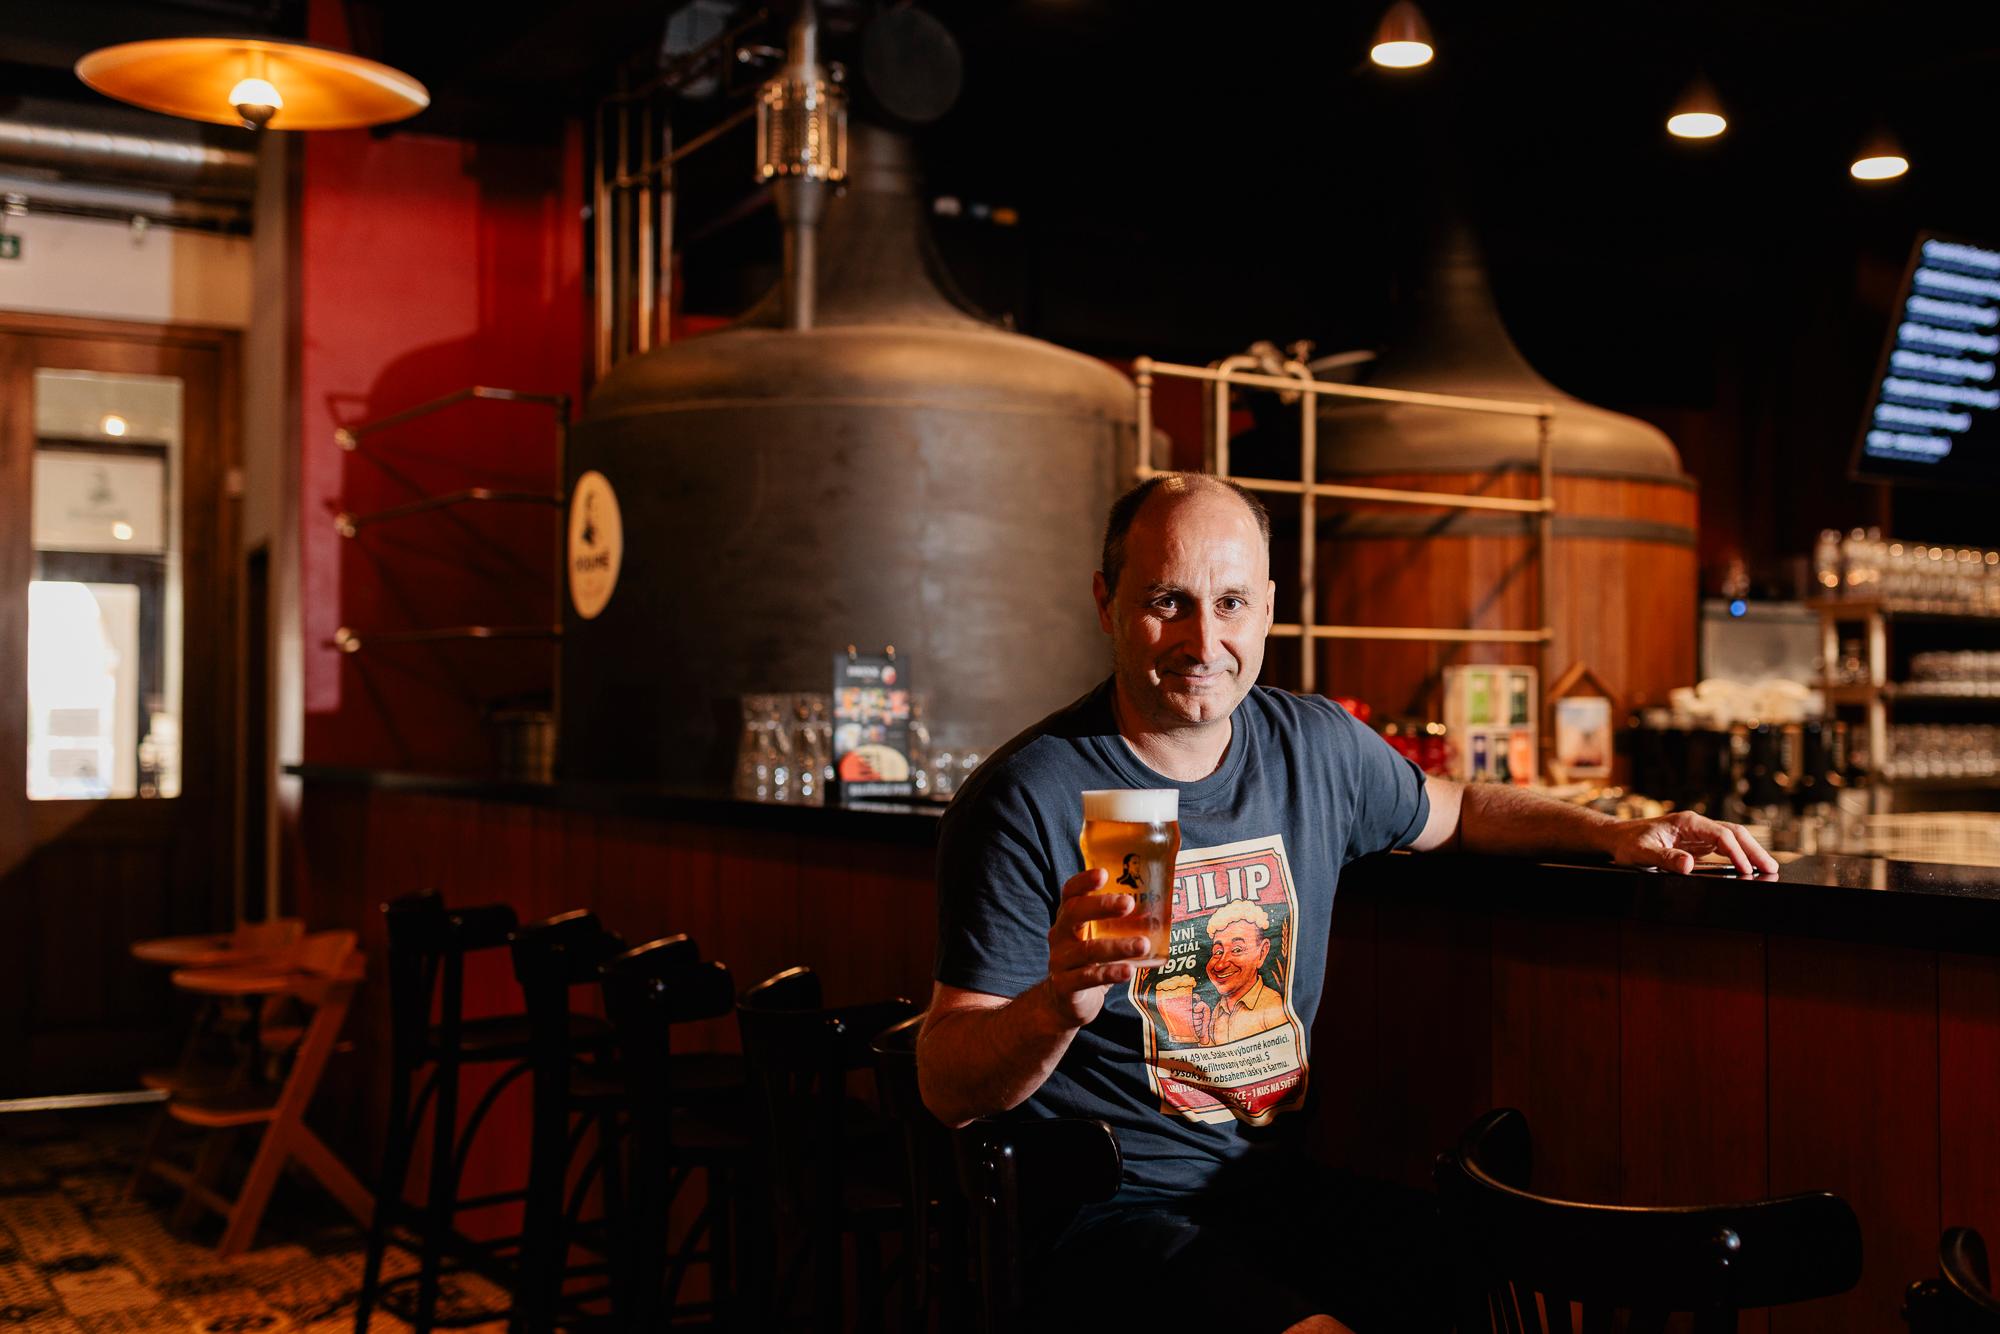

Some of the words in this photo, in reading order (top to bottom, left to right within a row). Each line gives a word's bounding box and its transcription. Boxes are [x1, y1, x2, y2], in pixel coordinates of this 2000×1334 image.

[1169, 924, 1195, 943] IVNÍ
[1157, 954, 1197, 975] 1976
[1190, 1053, 1201, 1063] 49
[1233, 1043, 1262, 1057] výborné
[1264, 1051, 1270, 1061] S
[1214, 1071, 1247, 1083] obsahem
[1256, 1084, 1271, 1097] KUS
[1271, 1082, 1280, 1094] NA
